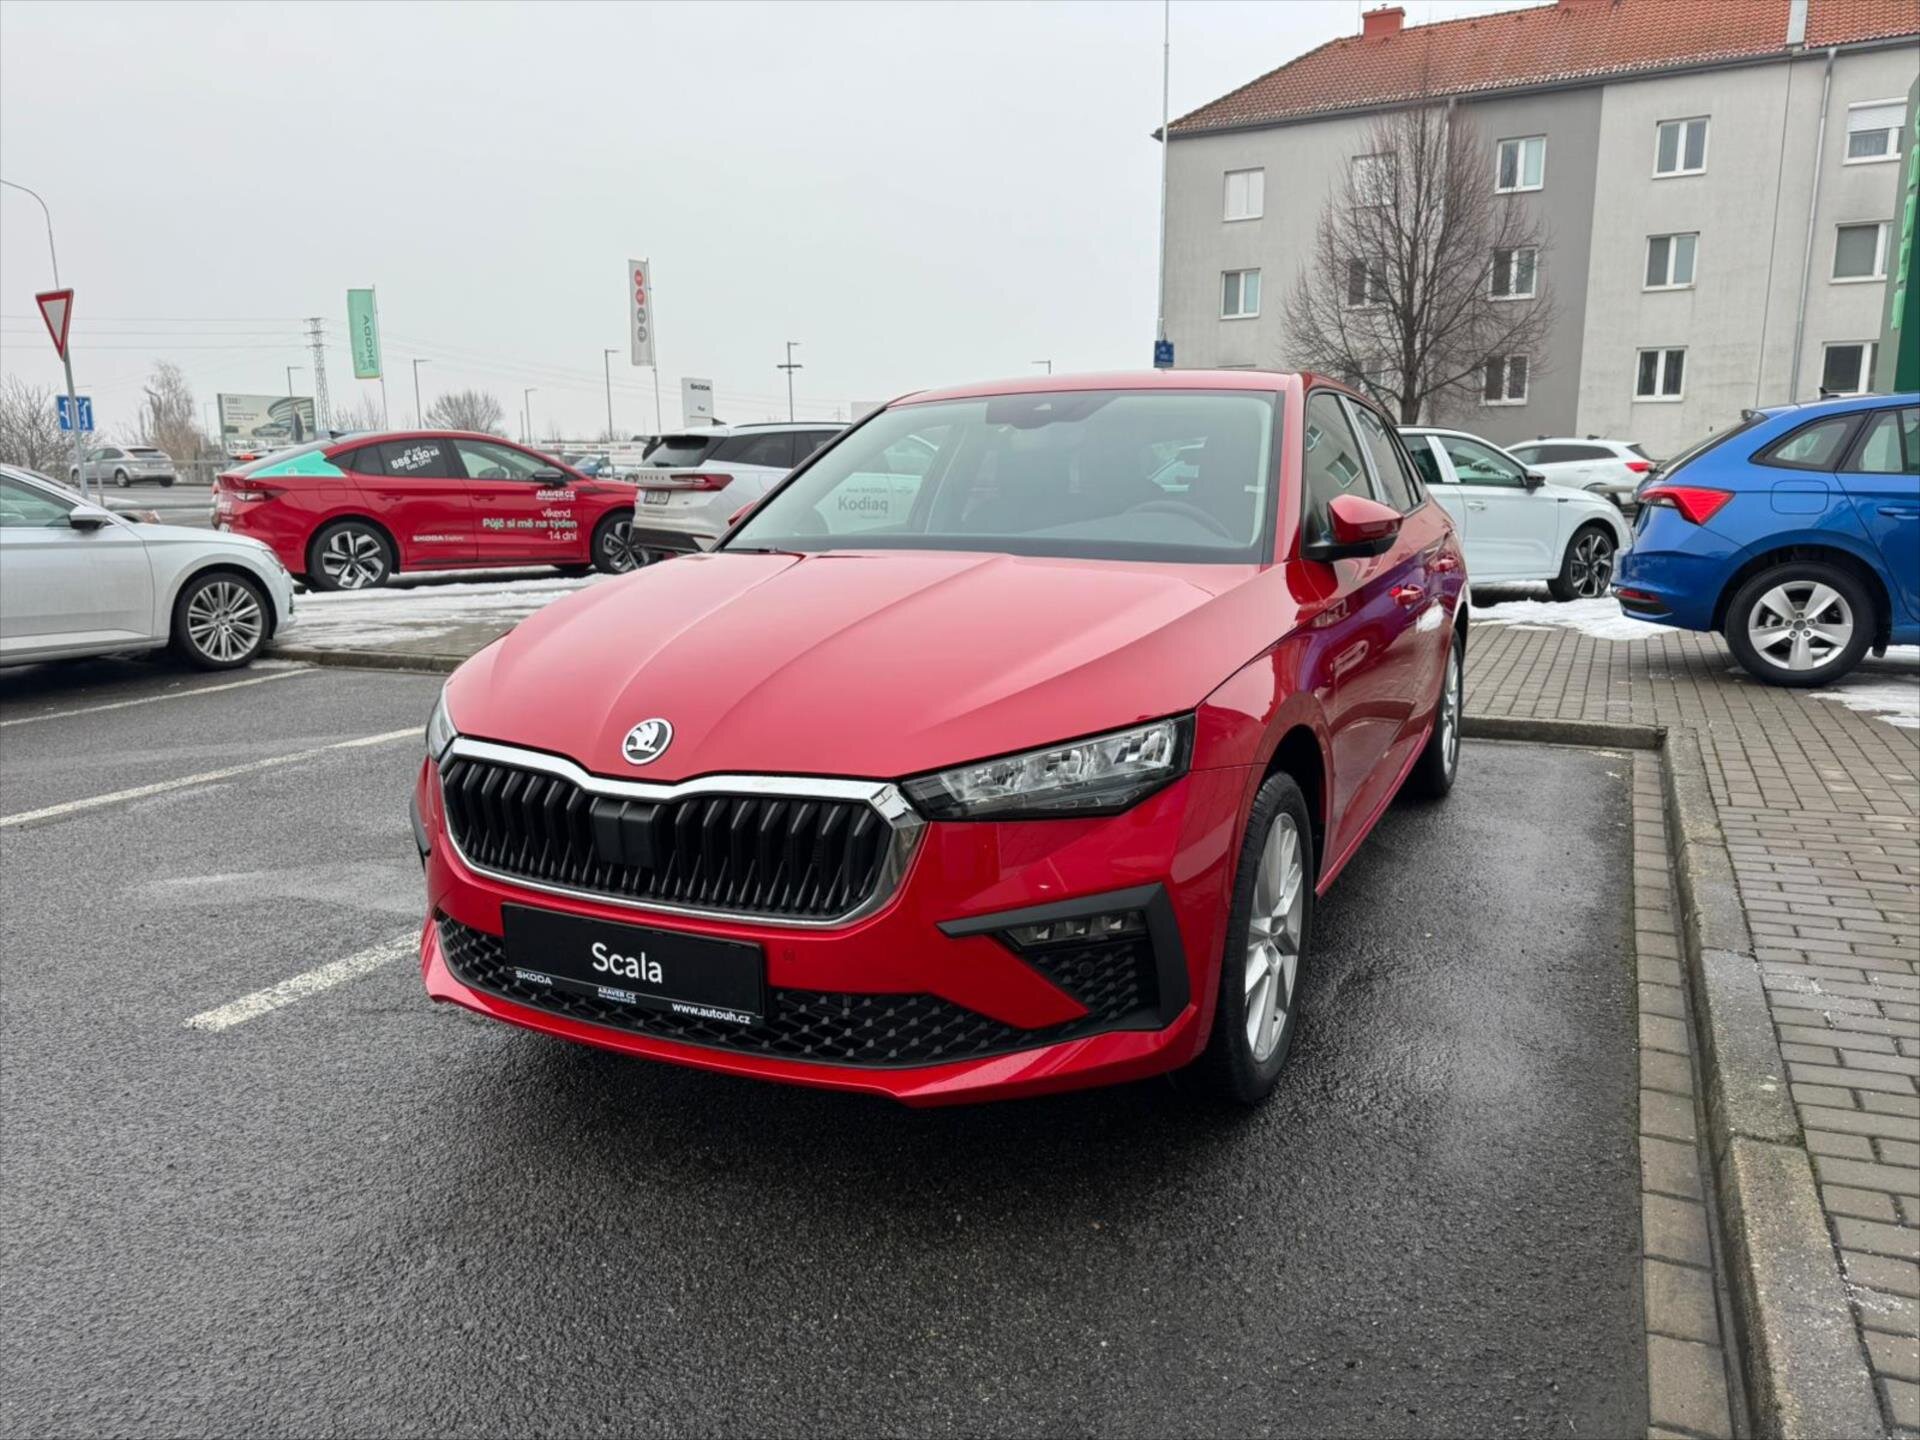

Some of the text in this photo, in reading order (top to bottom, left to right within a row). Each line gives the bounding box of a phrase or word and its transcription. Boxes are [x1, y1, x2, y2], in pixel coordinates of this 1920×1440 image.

[838, 495, 889, 514] Kodiaq
[535, 520, 548, 528] na
[547, 531, 560, 540] 14
[591, 942, 663, 984] Scala
[671, 1003, 751, 1025] www.autouh.cz
